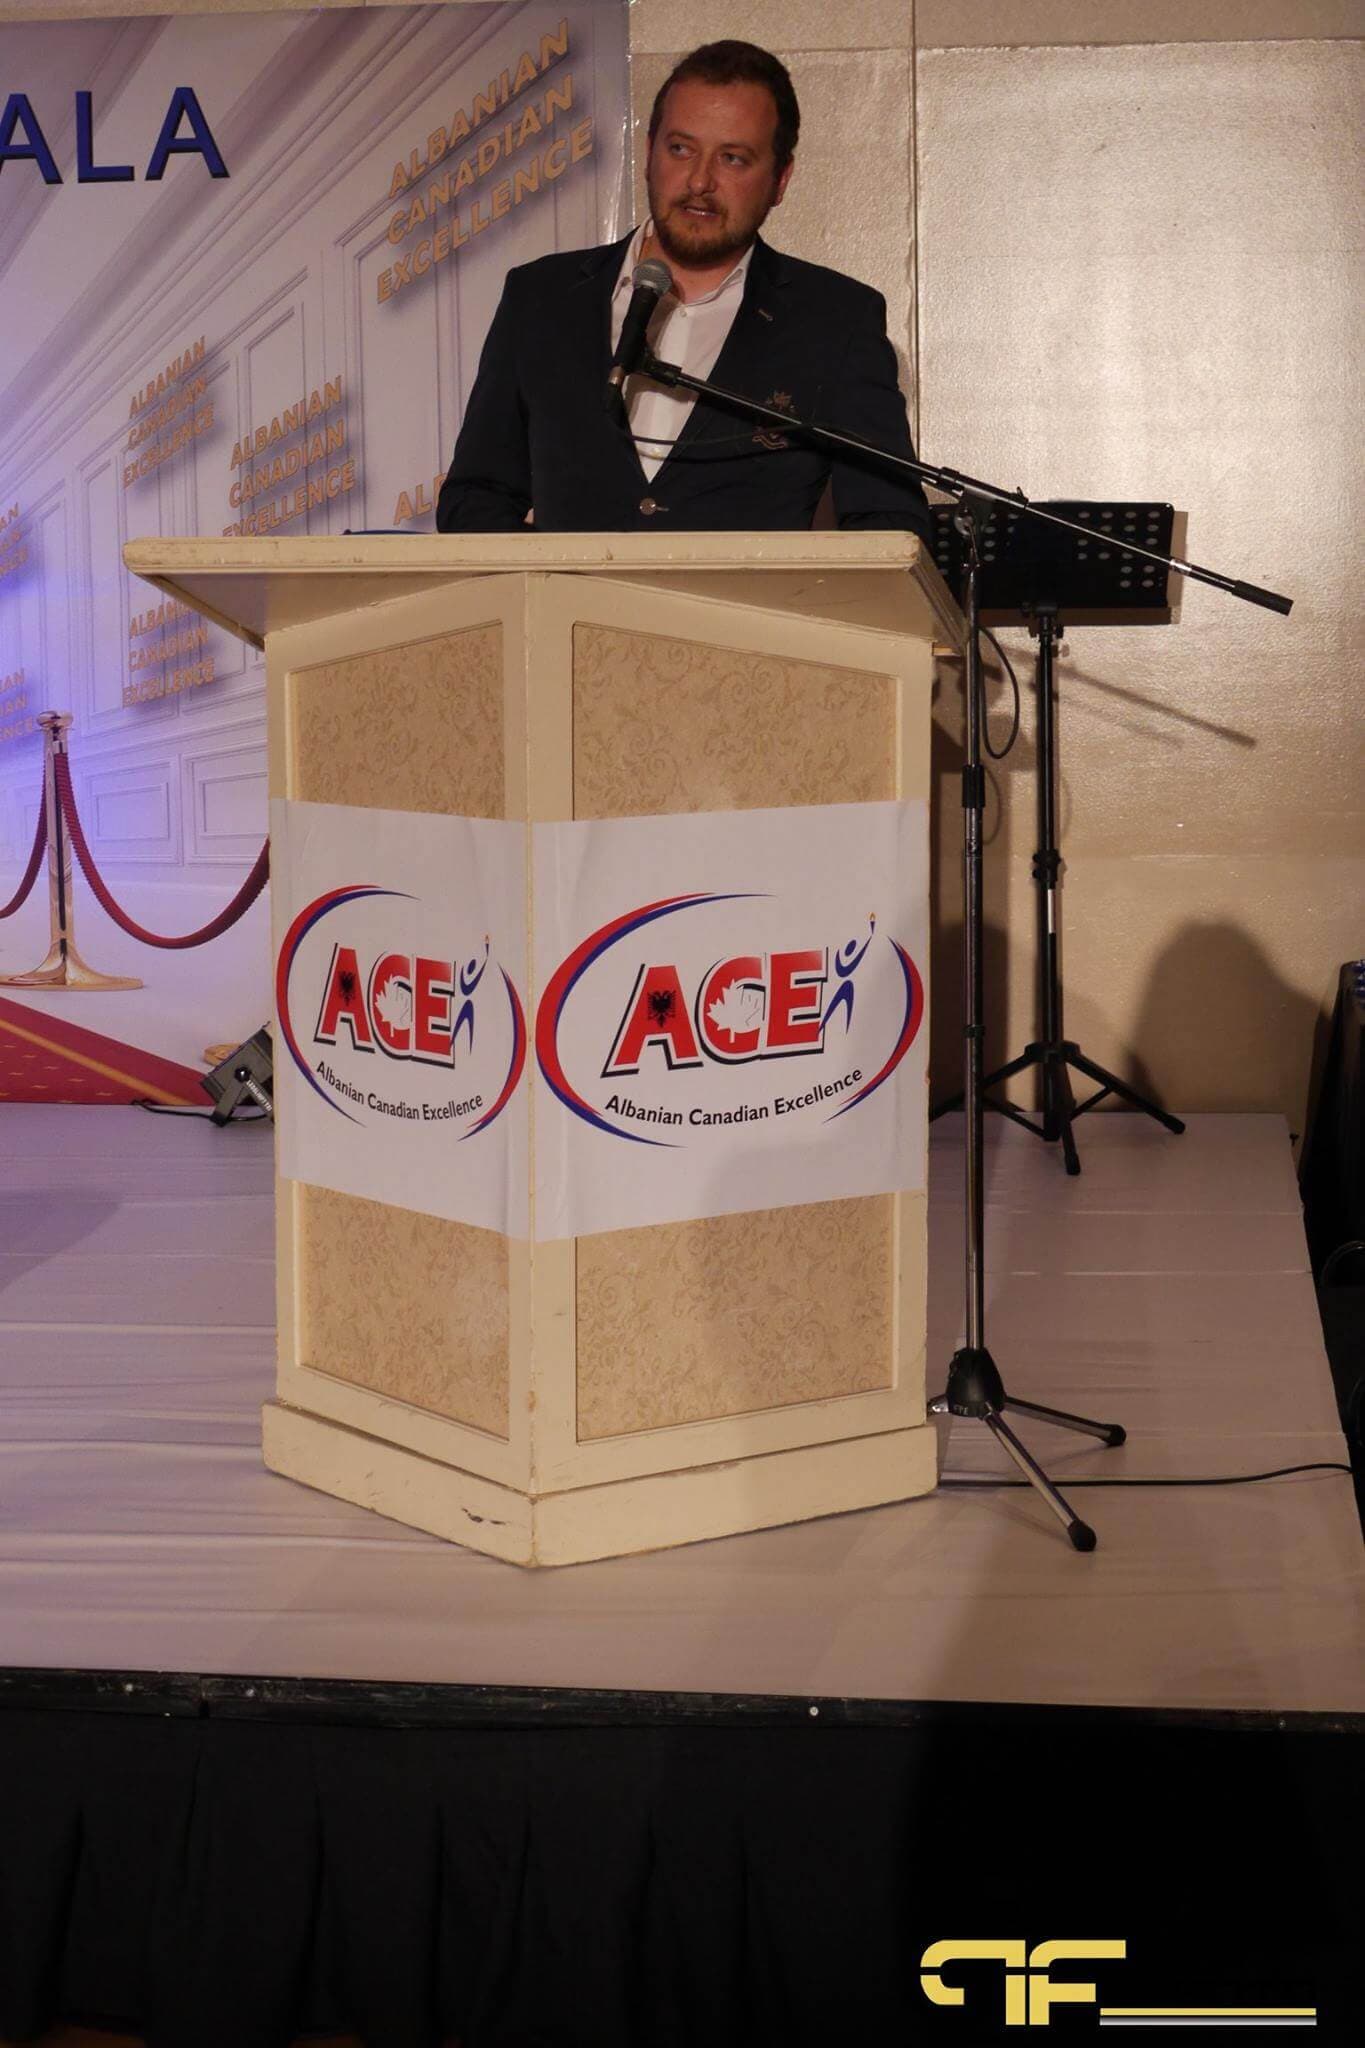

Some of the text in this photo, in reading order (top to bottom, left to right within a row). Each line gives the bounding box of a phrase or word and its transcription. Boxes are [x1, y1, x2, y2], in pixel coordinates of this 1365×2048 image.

[0, 86, 230, 184] ALA
[388, 17, 569, 199] ALBANIAN
[387, 73, 573, 245] CANADIAN
[377, 116, 593, 304] EXCELLENCE
[128, 335, 205, 420] ALBANIAN
[230, 375, 342, 471] ALBANIAN
[122, 400, 215, 489] EXCELLENCE
[228, 419, 344, 509] CANADIAN
[313, 942, 455, 1069] ACE
[600, 947, 828, 1078] ACE
[316, 1061, 483, 1121] Albanian Canadian Excellence
[605, 1069, 863, 1126] Albanian Canadian Excellence
